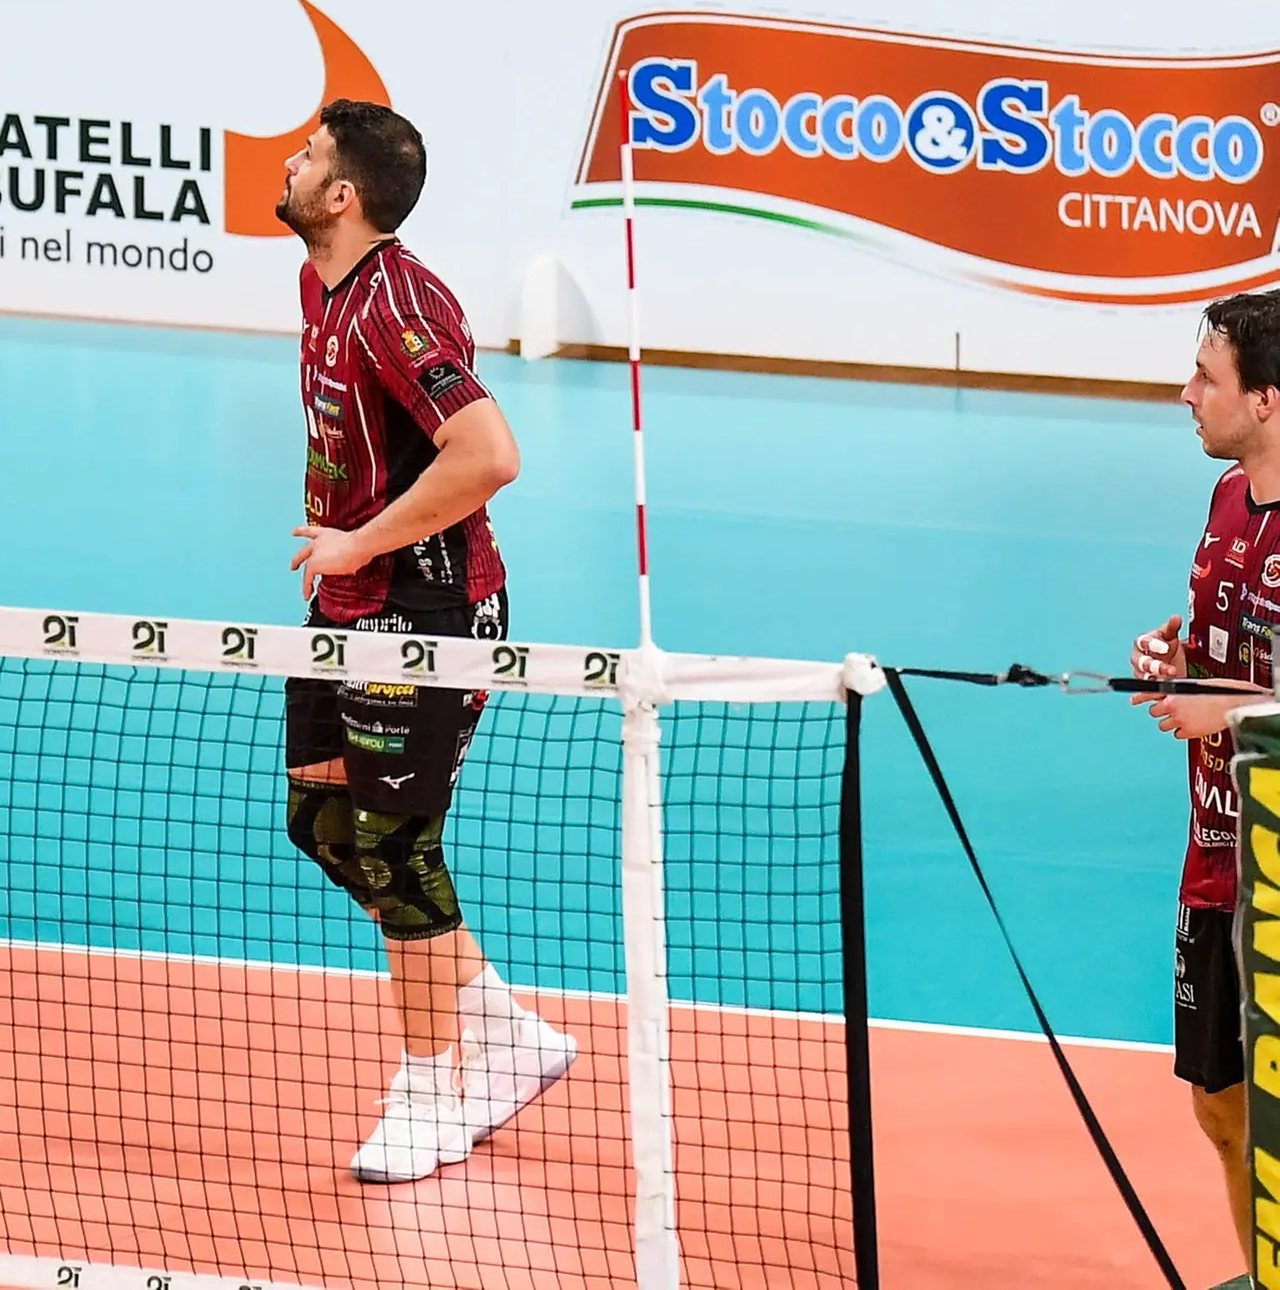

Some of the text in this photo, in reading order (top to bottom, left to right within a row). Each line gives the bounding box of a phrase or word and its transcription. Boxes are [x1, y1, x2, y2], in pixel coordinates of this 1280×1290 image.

[1056, 191, 1262, 239] CITTANOVA
[21, 229, 72, 263] nel
[88, 235, 215, 273] mondo
[1216, 581, 1235, 612] 5
